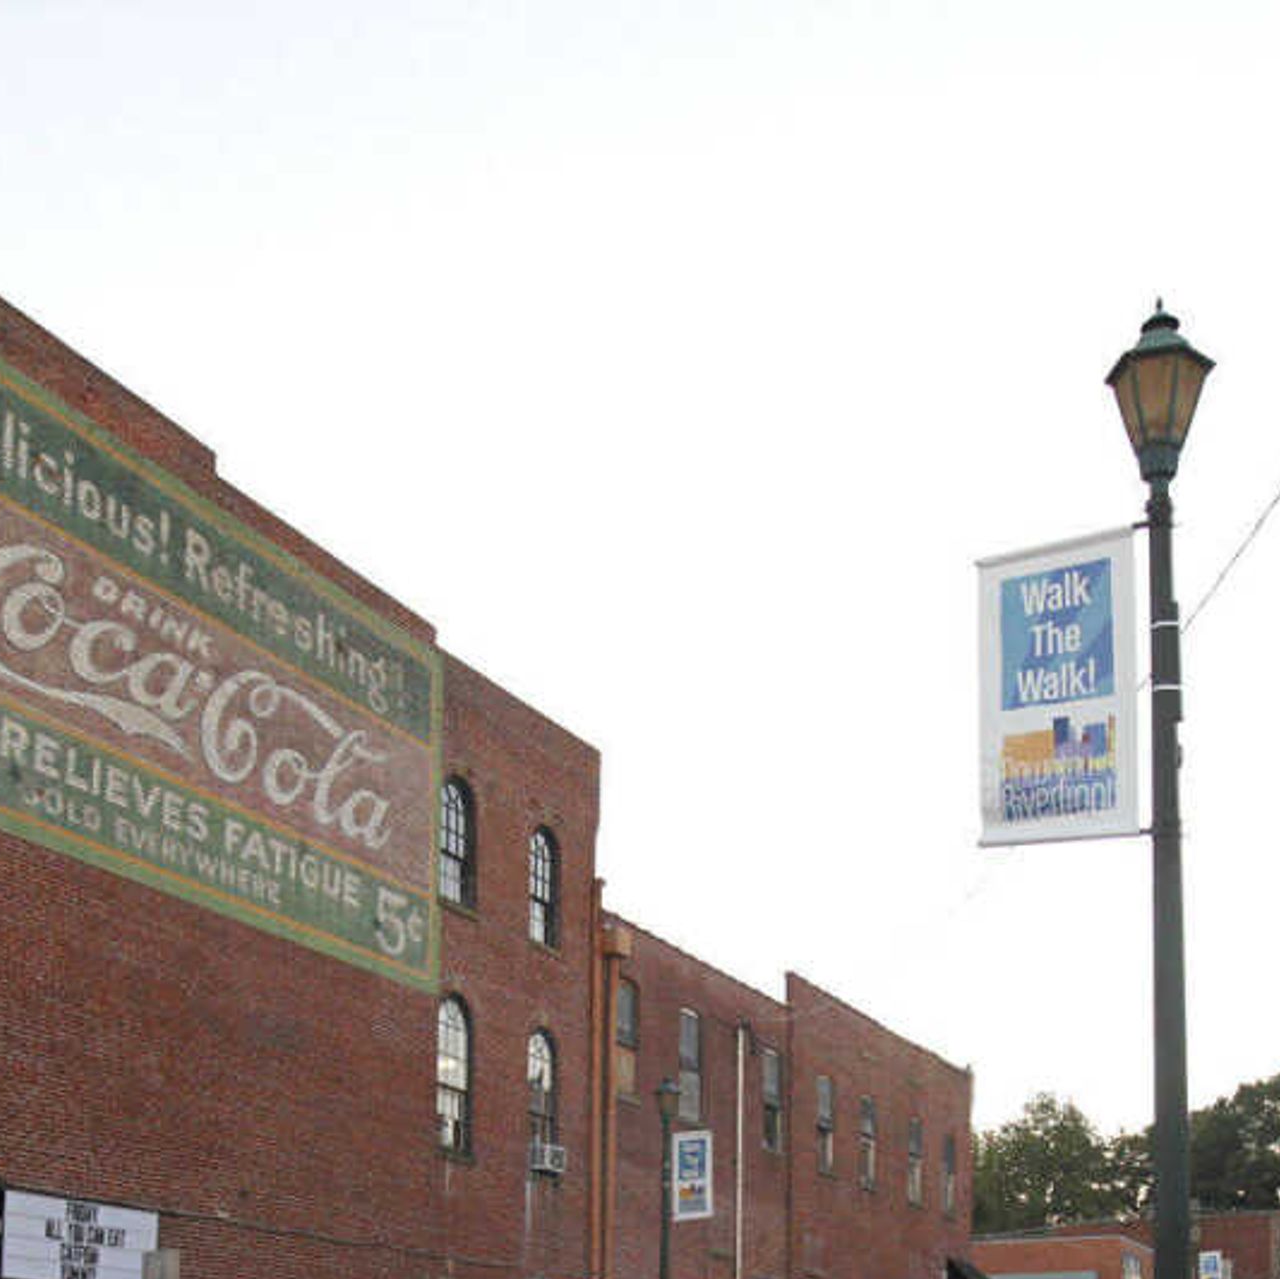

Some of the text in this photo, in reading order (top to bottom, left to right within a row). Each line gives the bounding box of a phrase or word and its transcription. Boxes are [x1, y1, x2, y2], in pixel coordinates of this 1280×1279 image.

[1021, 567, 1092, 616] Walk
[91, 574, 218, 660] DRINK
[1030, 618, 1082, 657] The
[1017, 657, 1097, 702] Walk!
[0, 714, 209, 843] RELIEVES
[224, 817, 362, 906] FATIGUE
[114, 816, 281, 906] EVERYWHERE
[45, 1217, 126, 1248] ALL YOU CAN EAT
